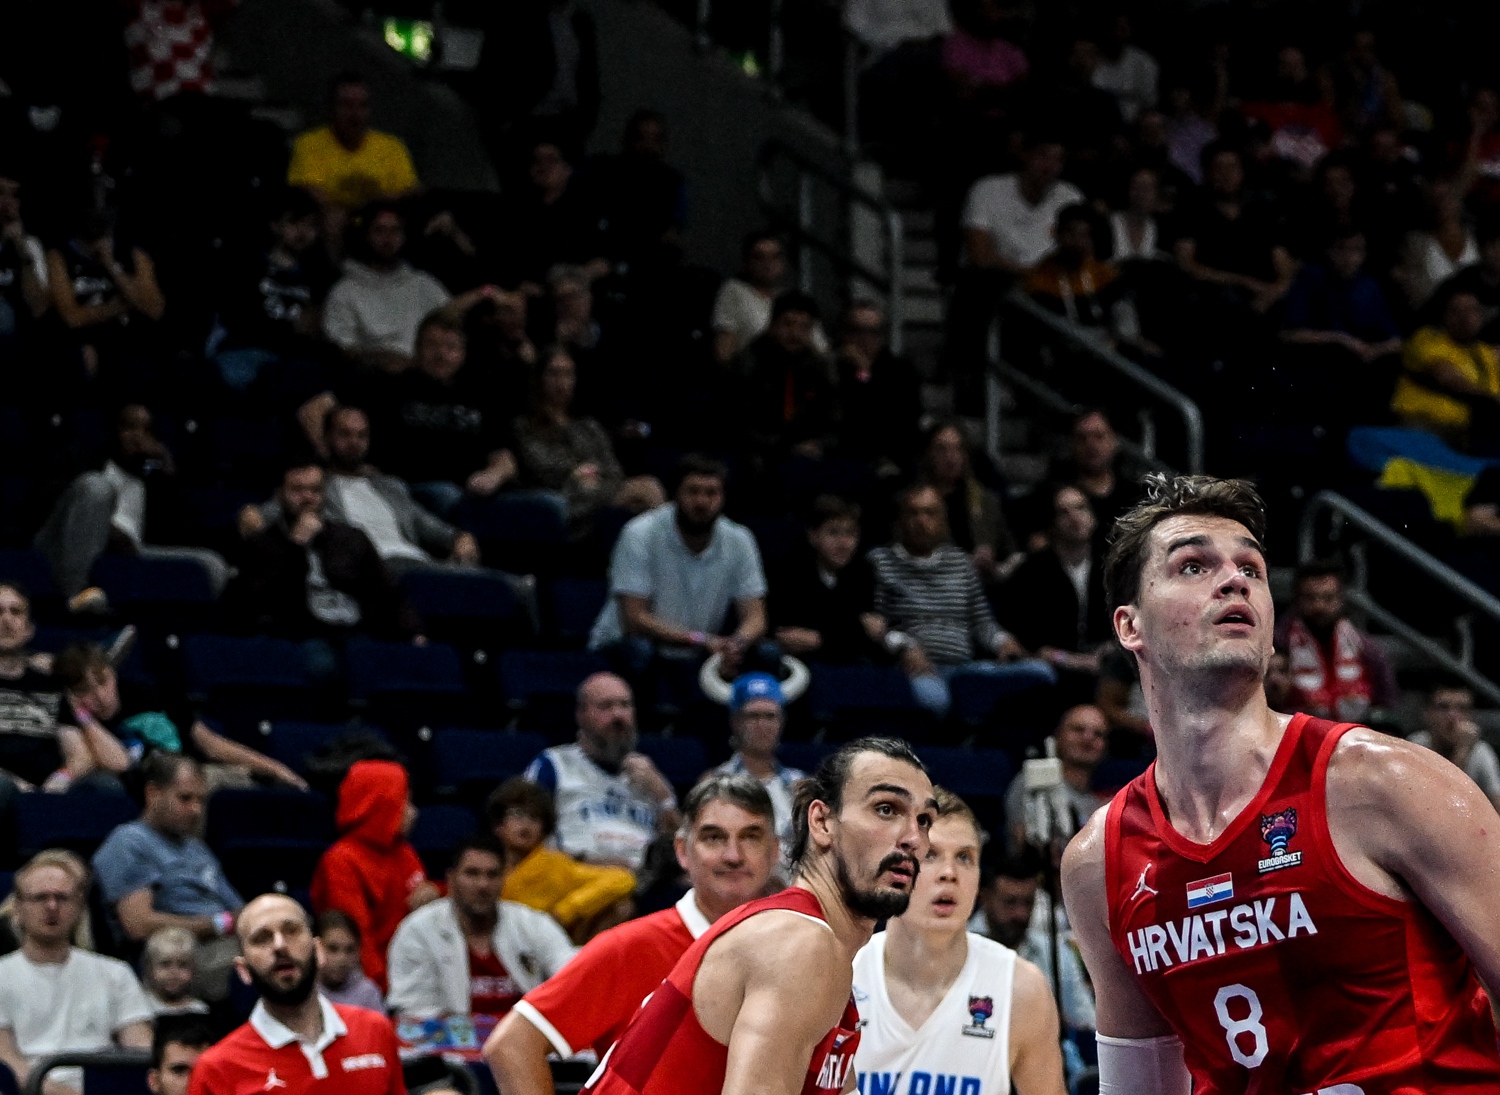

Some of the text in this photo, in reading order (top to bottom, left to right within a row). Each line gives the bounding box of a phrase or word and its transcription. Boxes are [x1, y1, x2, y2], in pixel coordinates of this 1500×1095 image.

[1258, 851, 1302, 869] EUROBASKET
[1127, 892, 1318, 975] HRVATSKA
[1213, 983, 1270, 1069] 8
